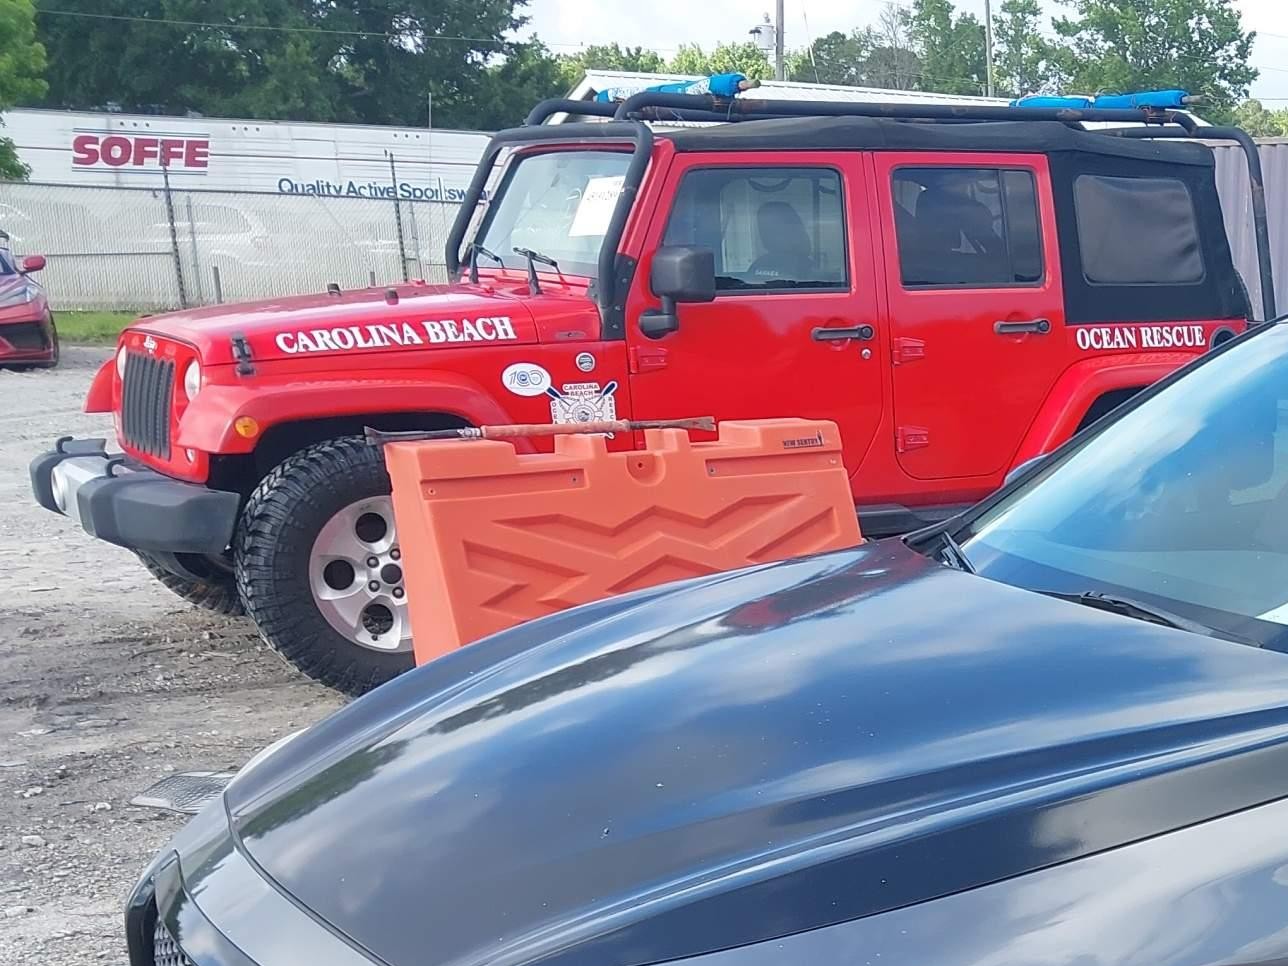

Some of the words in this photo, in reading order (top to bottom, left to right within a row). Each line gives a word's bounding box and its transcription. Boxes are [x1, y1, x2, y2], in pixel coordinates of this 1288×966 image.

[73, 135, 209, 168] SOFFE
[278, 178, 343, 195] Quality
[346, 181, 395, 198] Active
[275, 322, 423, 353] CAROLINA
[423, 317, 517, 343] BEACH
[1076, 327, 1137, 350] OCEAN
[1140, 325, 1206, 348] RESCUE
